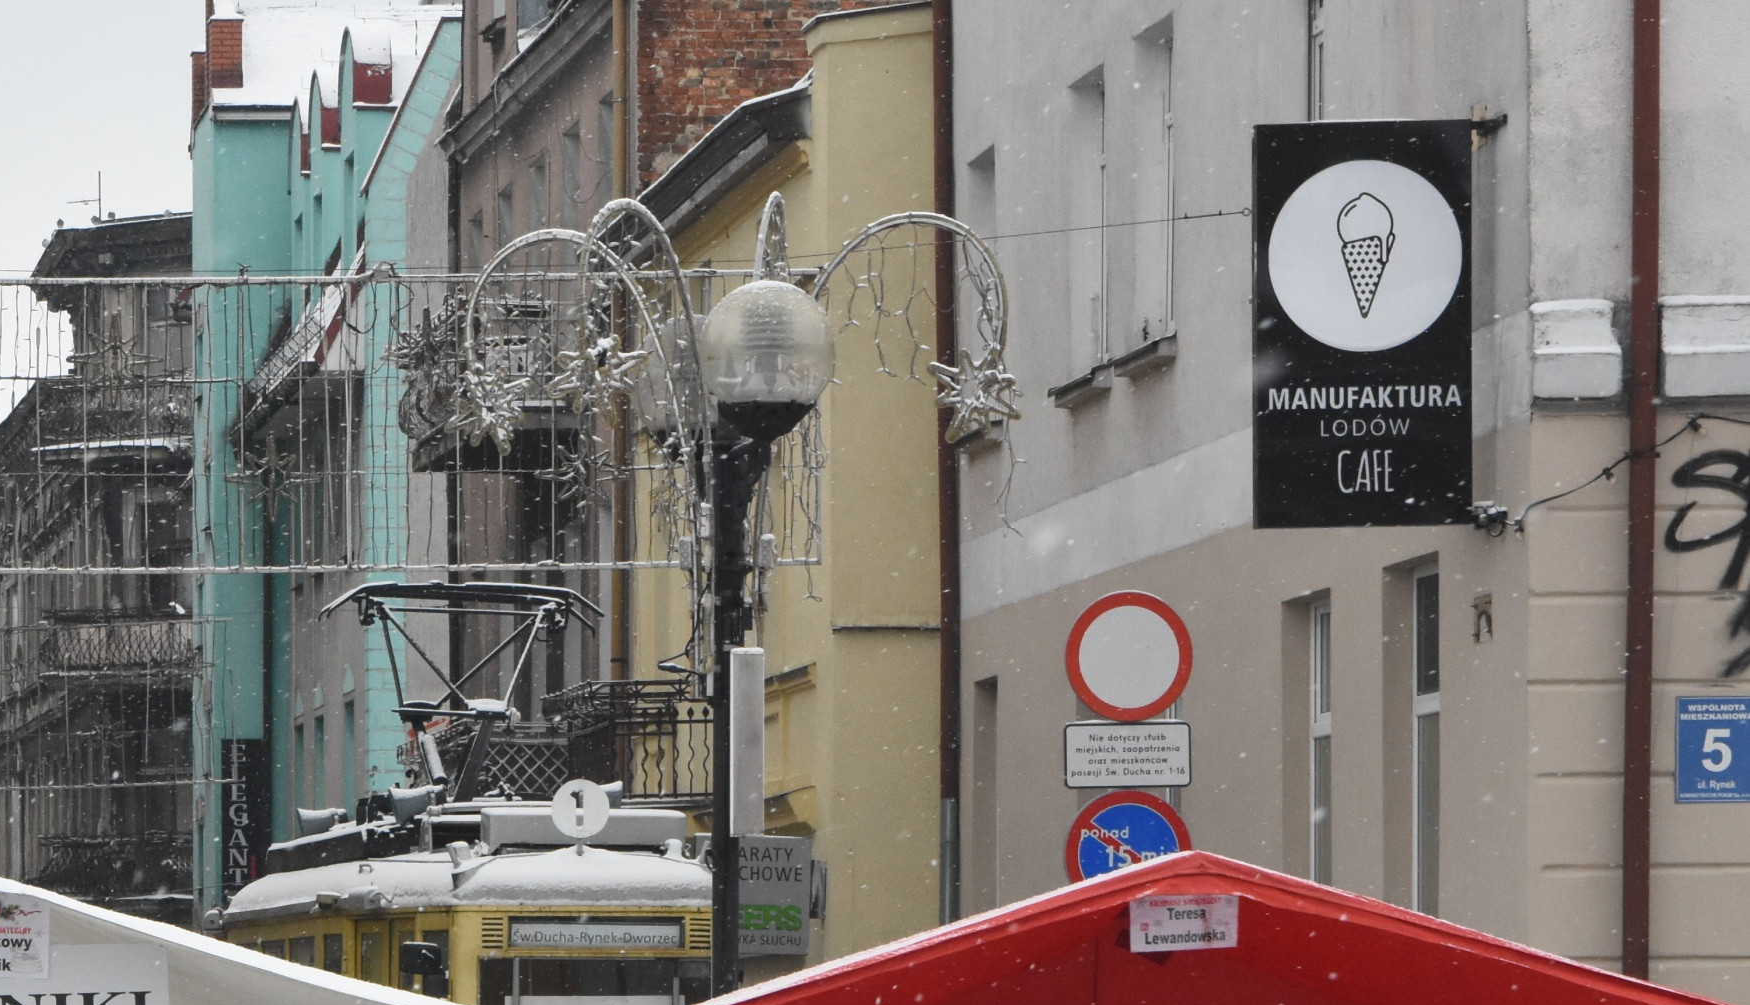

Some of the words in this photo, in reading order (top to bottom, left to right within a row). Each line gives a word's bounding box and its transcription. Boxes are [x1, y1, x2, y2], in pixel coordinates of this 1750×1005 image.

[1268, 385, 1463, 410] MANUFAKTURA
[1320, 414, 1410, 437] LODÓW
[1337, 449, 1395, 493] CAFE
[1089, 734, 1104, 742] Nie
[1107, 733, 1141, 743] dotyczy
[1122, 743, 1180, 754] zaopatrzenia
[1701, 728, 1732, 772] 5
[1088, 757, 1107, 765] oraz
[1071, 767, 1102, 778] posesji
[1123, 767, 1151, 776] Ducha
[1169, 766, 1185, 775] 1-16
[1697, 780, 1707, 789] ul.
[1709, 780, 1736, 791] Rynek
[228, 744, 249, 886] ELEGANT
[570, 788, 585, 828] 1
[1080, 825, 1129, 841] ponad
[1106, 845, 1132, 868] 15
[738, 865, 803, 882] CHOWE
[1166, 907, 1206, 921] Teresa
[1144, 928, 1226, 945] Lewandowska
